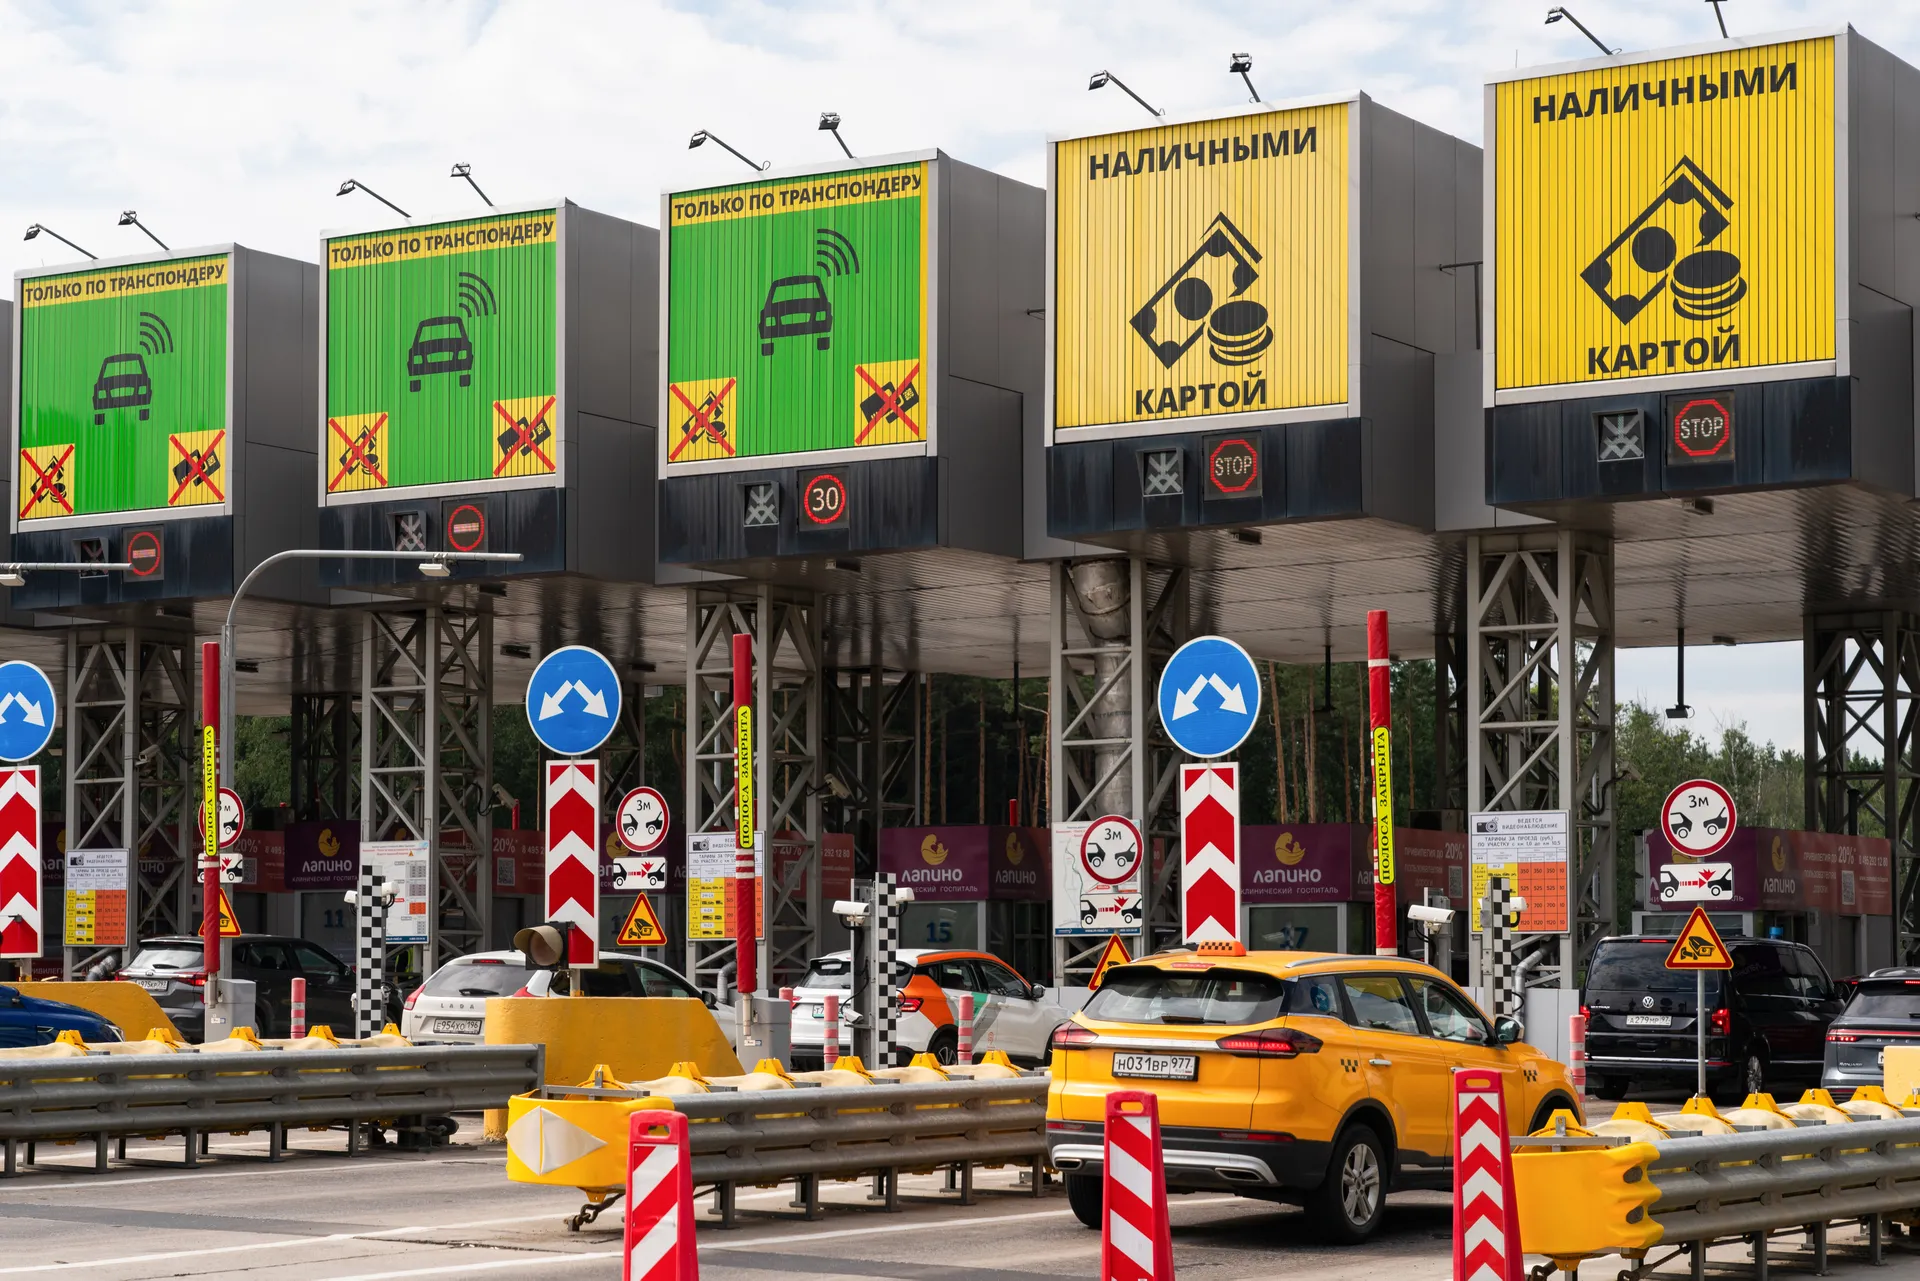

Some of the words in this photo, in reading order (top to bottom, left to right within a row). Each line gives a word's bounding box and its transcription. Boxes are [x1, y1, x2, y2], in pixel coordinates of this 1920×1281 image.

[1533, 62, 1797, 123] НАЛИЧНЫМИ
[1090, 126, 1317, 180] НАЛИЧНЫМИ
[674, 196, 744, 220] ТОЛЬКО
[749, 192, 775, 211] ПО
[779, 172, 921, 207] ТРАНСПОНДЕРУ
[331, 241, 394, 263] ТОЛЬКО
[398, 238, 421, 254] ПО
[425, 221, 554, 251] ТРАНСПОНДЕРУ
[25, 282, 82, 302] ТОЛЬКО
[86, 278, 106, 295] ПО
[110, 263, 225, 292] ТРАНСПОНДЕРУ
[1588, 325, 1739, 374] КАРТОЙ
[1135, 370, 1267, 415] КАРТОЙ
[1679, 417, 1724, 439] STOP
[1214, 455, 1252, 477] STOP
[812, 486, 839, 512] 30
[740, 710, 748, 779] ЗАКРЫТА
[1377, 731, 1387, 808] ЗАКРЫТА
[742, 784, 750, 845] ПОЛОСА
[1380, 815, 1390, 881] ПОЛОСА
[1117, 1056, 1168, 1072] Н031ВР
[1171, 1056, 1191, 1069] 977
